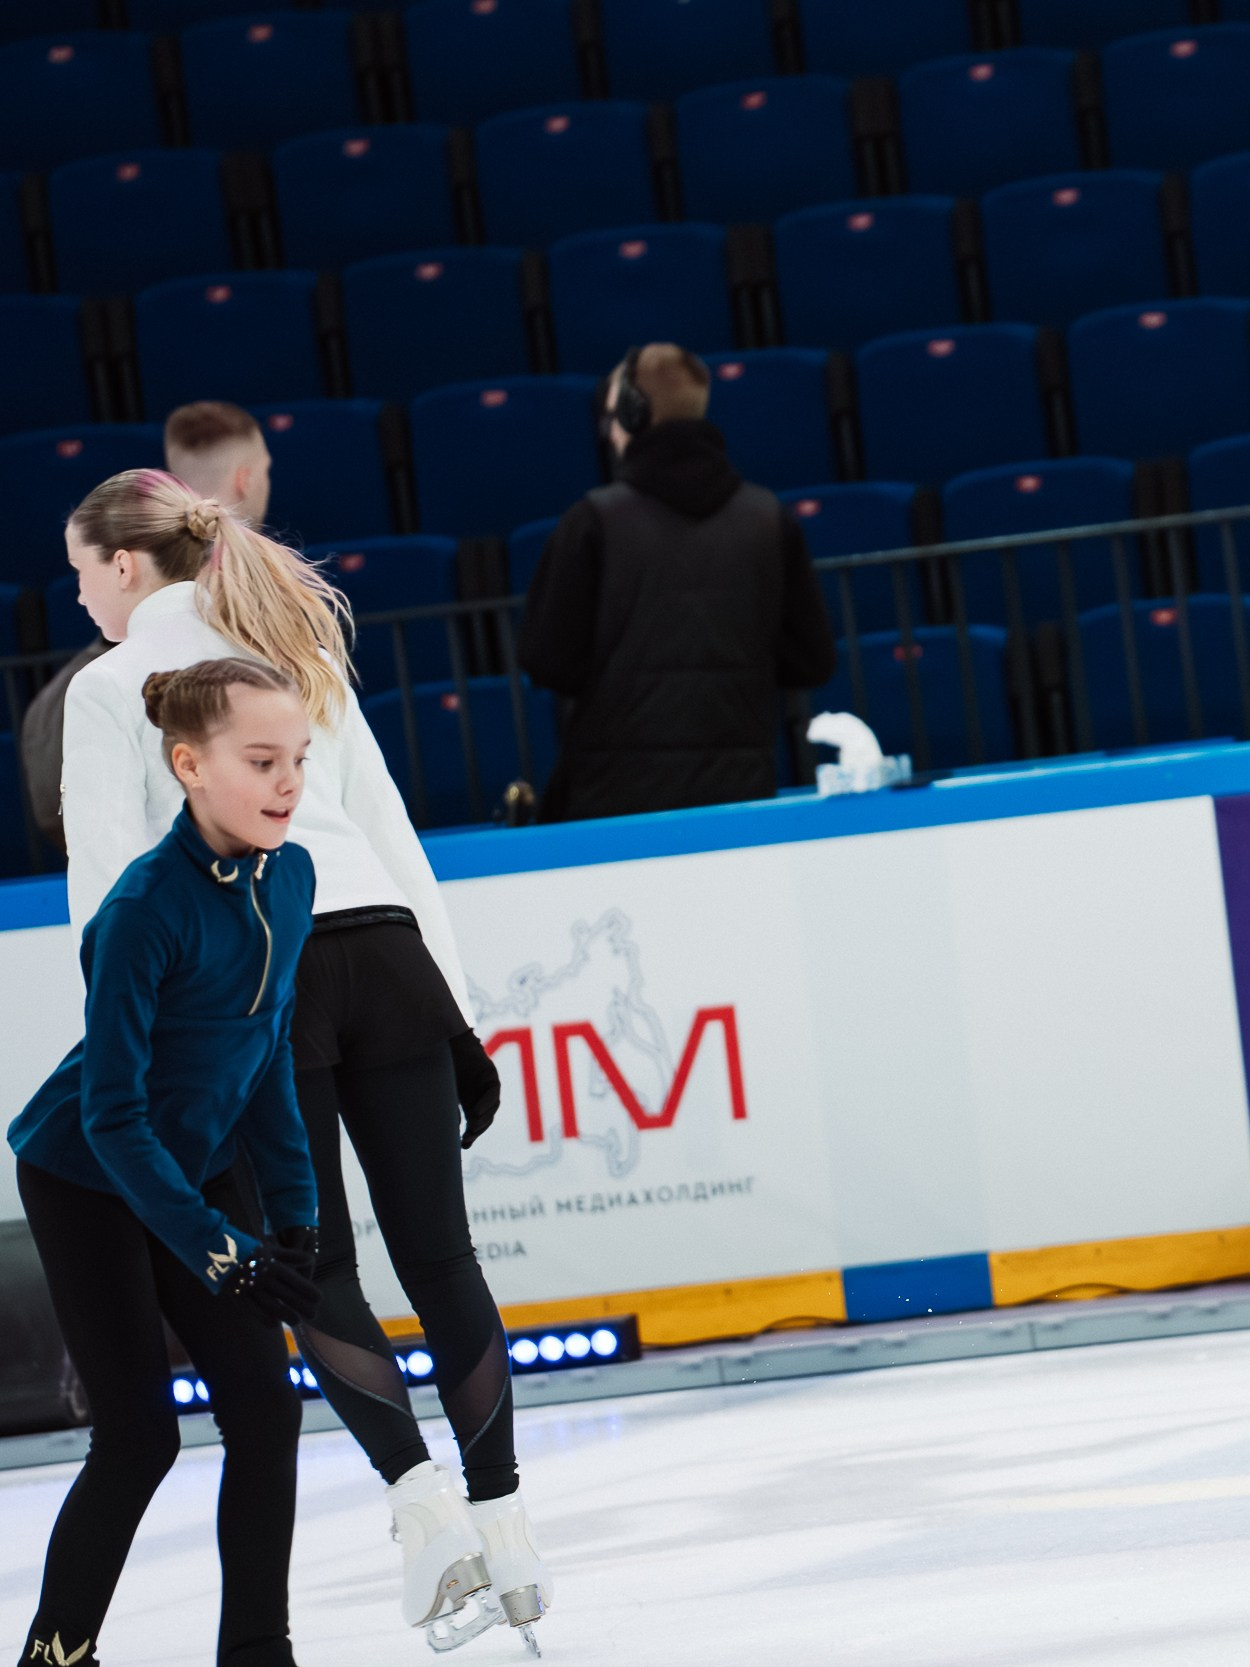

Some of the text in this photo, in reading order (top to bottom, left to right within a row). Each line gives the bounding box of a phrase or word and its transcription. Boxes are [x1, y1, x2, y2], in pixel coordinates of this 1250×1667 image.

[472, 1176, 754, 1224] ННЫЙ МЕДИАХОЛДИНГ
[476, 1240, 526, 1261] EDIA
